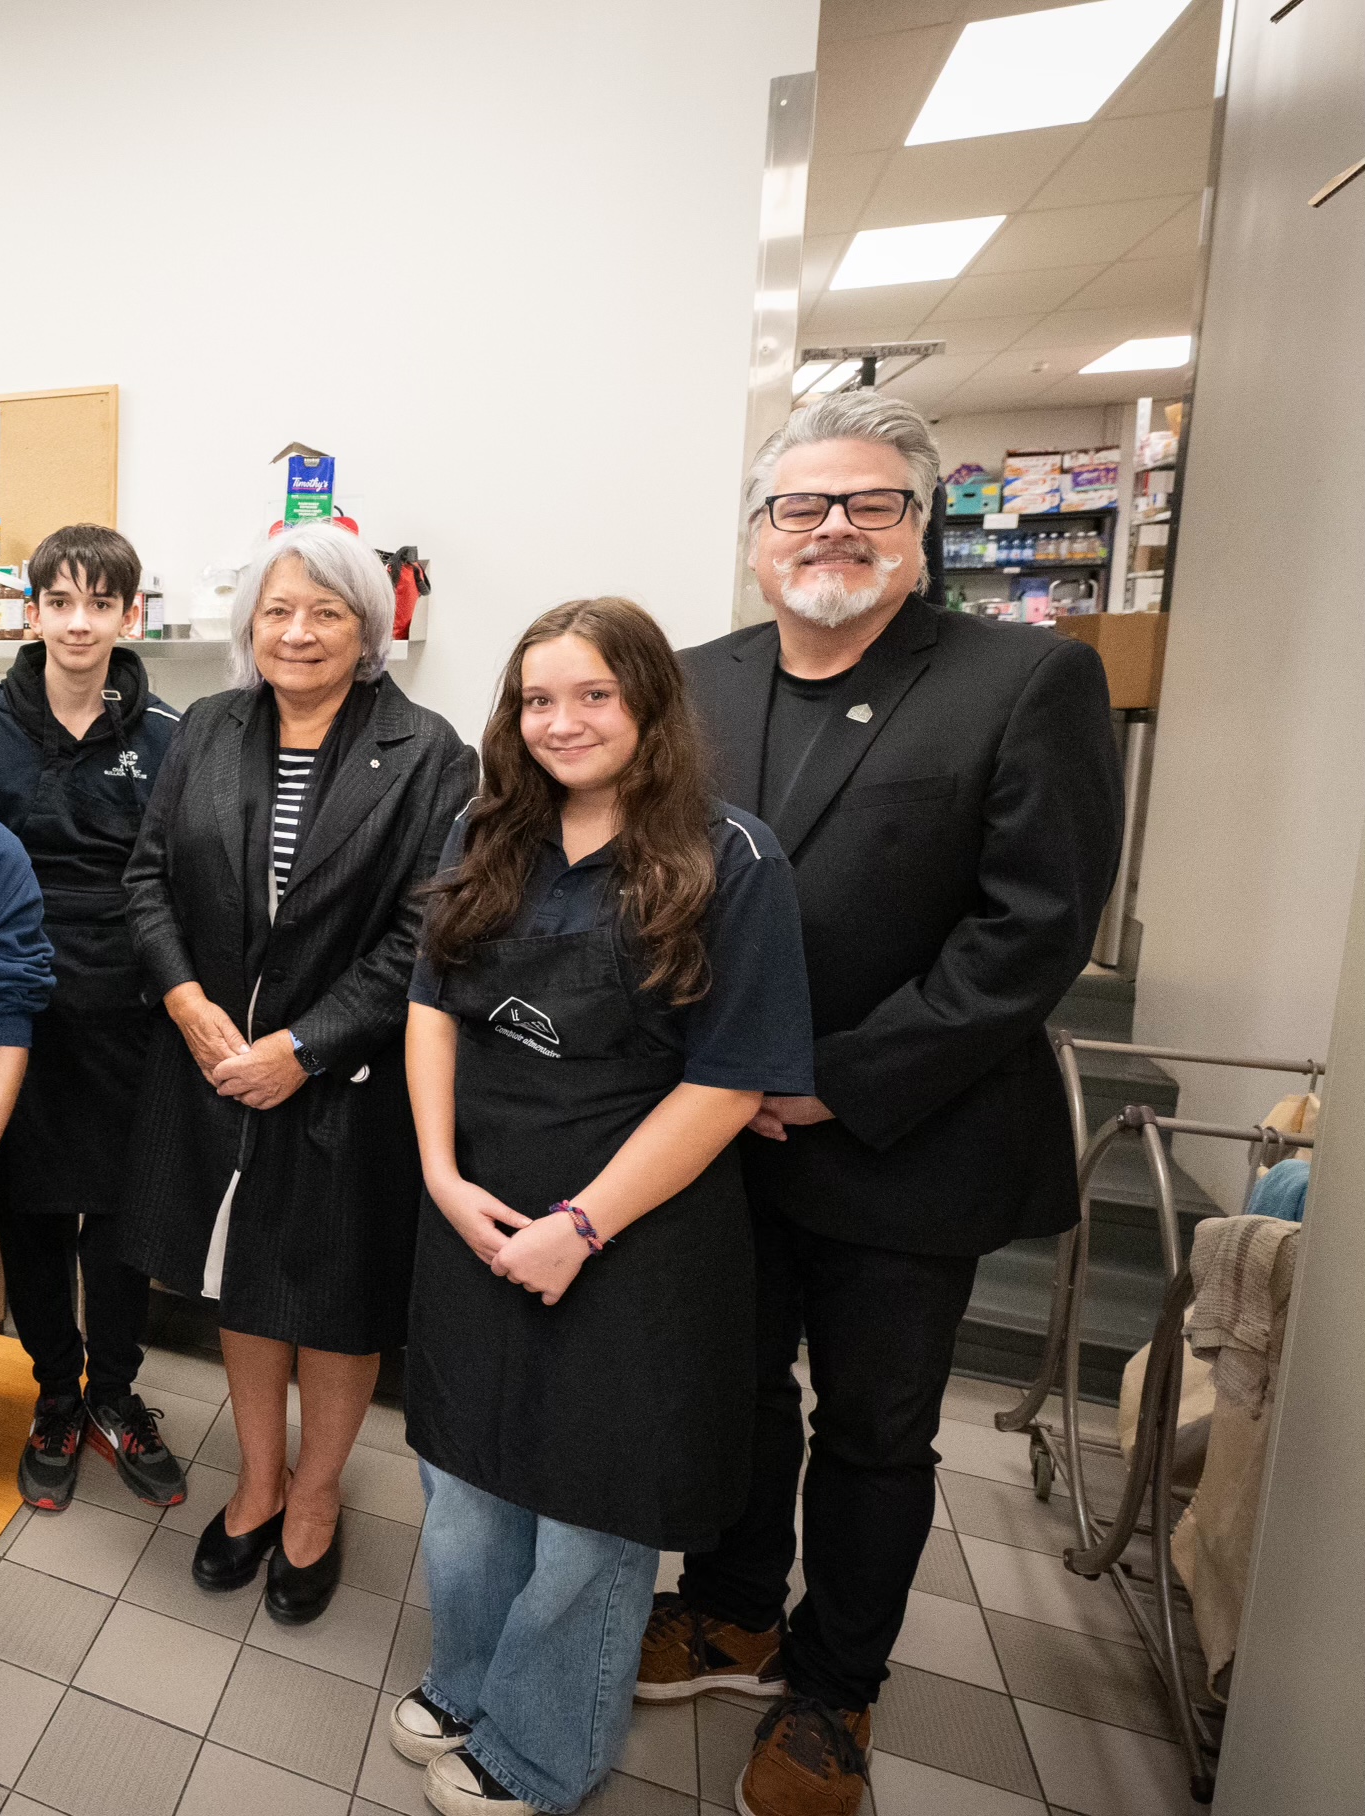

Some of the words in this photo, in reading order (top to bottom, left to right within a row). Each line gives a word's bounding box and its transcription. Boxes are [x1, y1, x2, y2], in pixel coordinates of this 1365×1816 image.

[292, 477, 328, 492] Timothy's
[510, 1008, 520, 1021] LE
[494, 1024, 524, 1041] Comptoir
[522, 1038, 562, 1058] alimentaire
